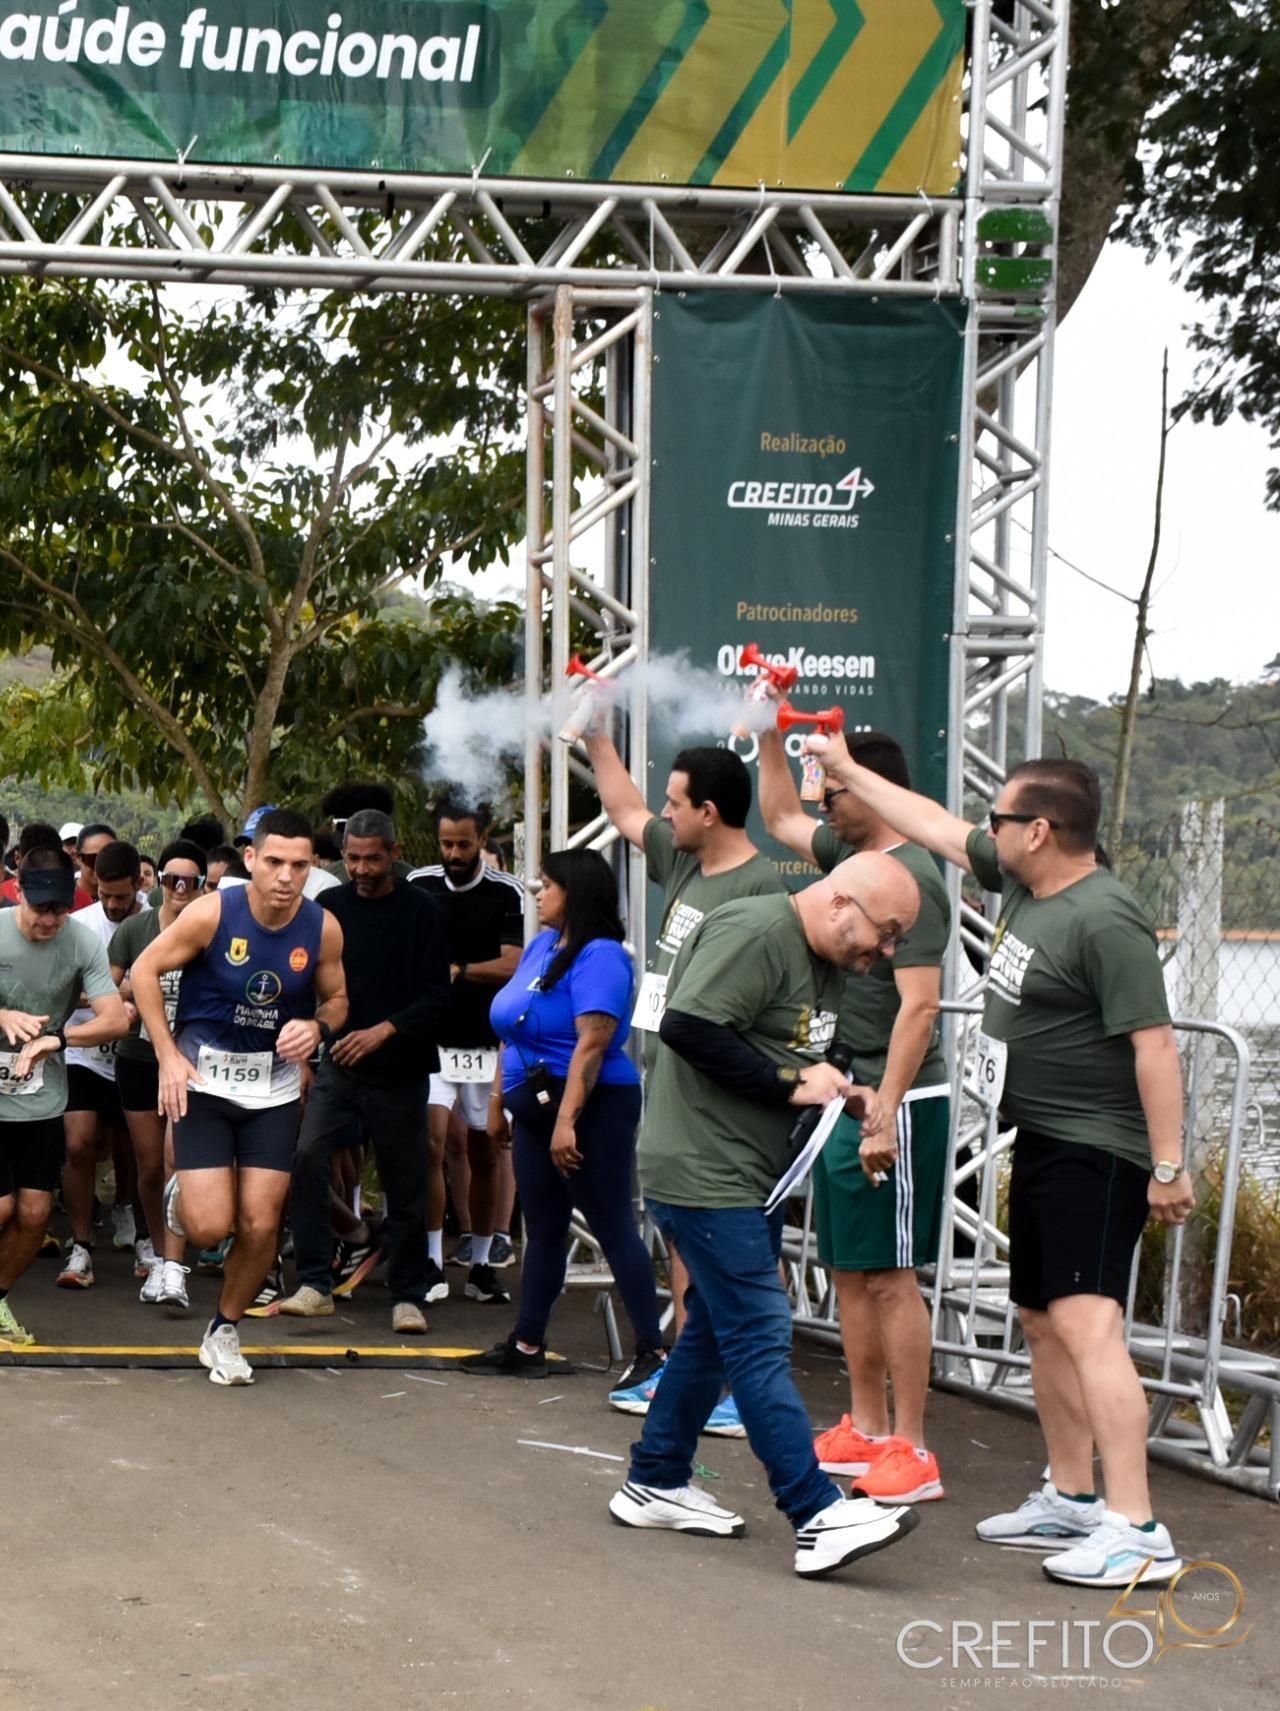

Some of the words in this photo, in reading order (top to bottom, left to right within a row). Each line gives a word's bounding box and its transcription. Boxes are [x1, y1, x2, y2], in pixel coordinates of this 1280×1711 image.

[179, 8, 481, 83] funcional
[760, 432, 846, 458] Realização
[767, 513, 810, 527] MINAS
[812, 514, 860, 528] GERAIS
[736, 601, 859, 623] Patrocinadores
[835, 685, 874, 696] VIDAS
[450, 1053, 483, 1070] 131
[209, 1064, 260, 1082] 1159
